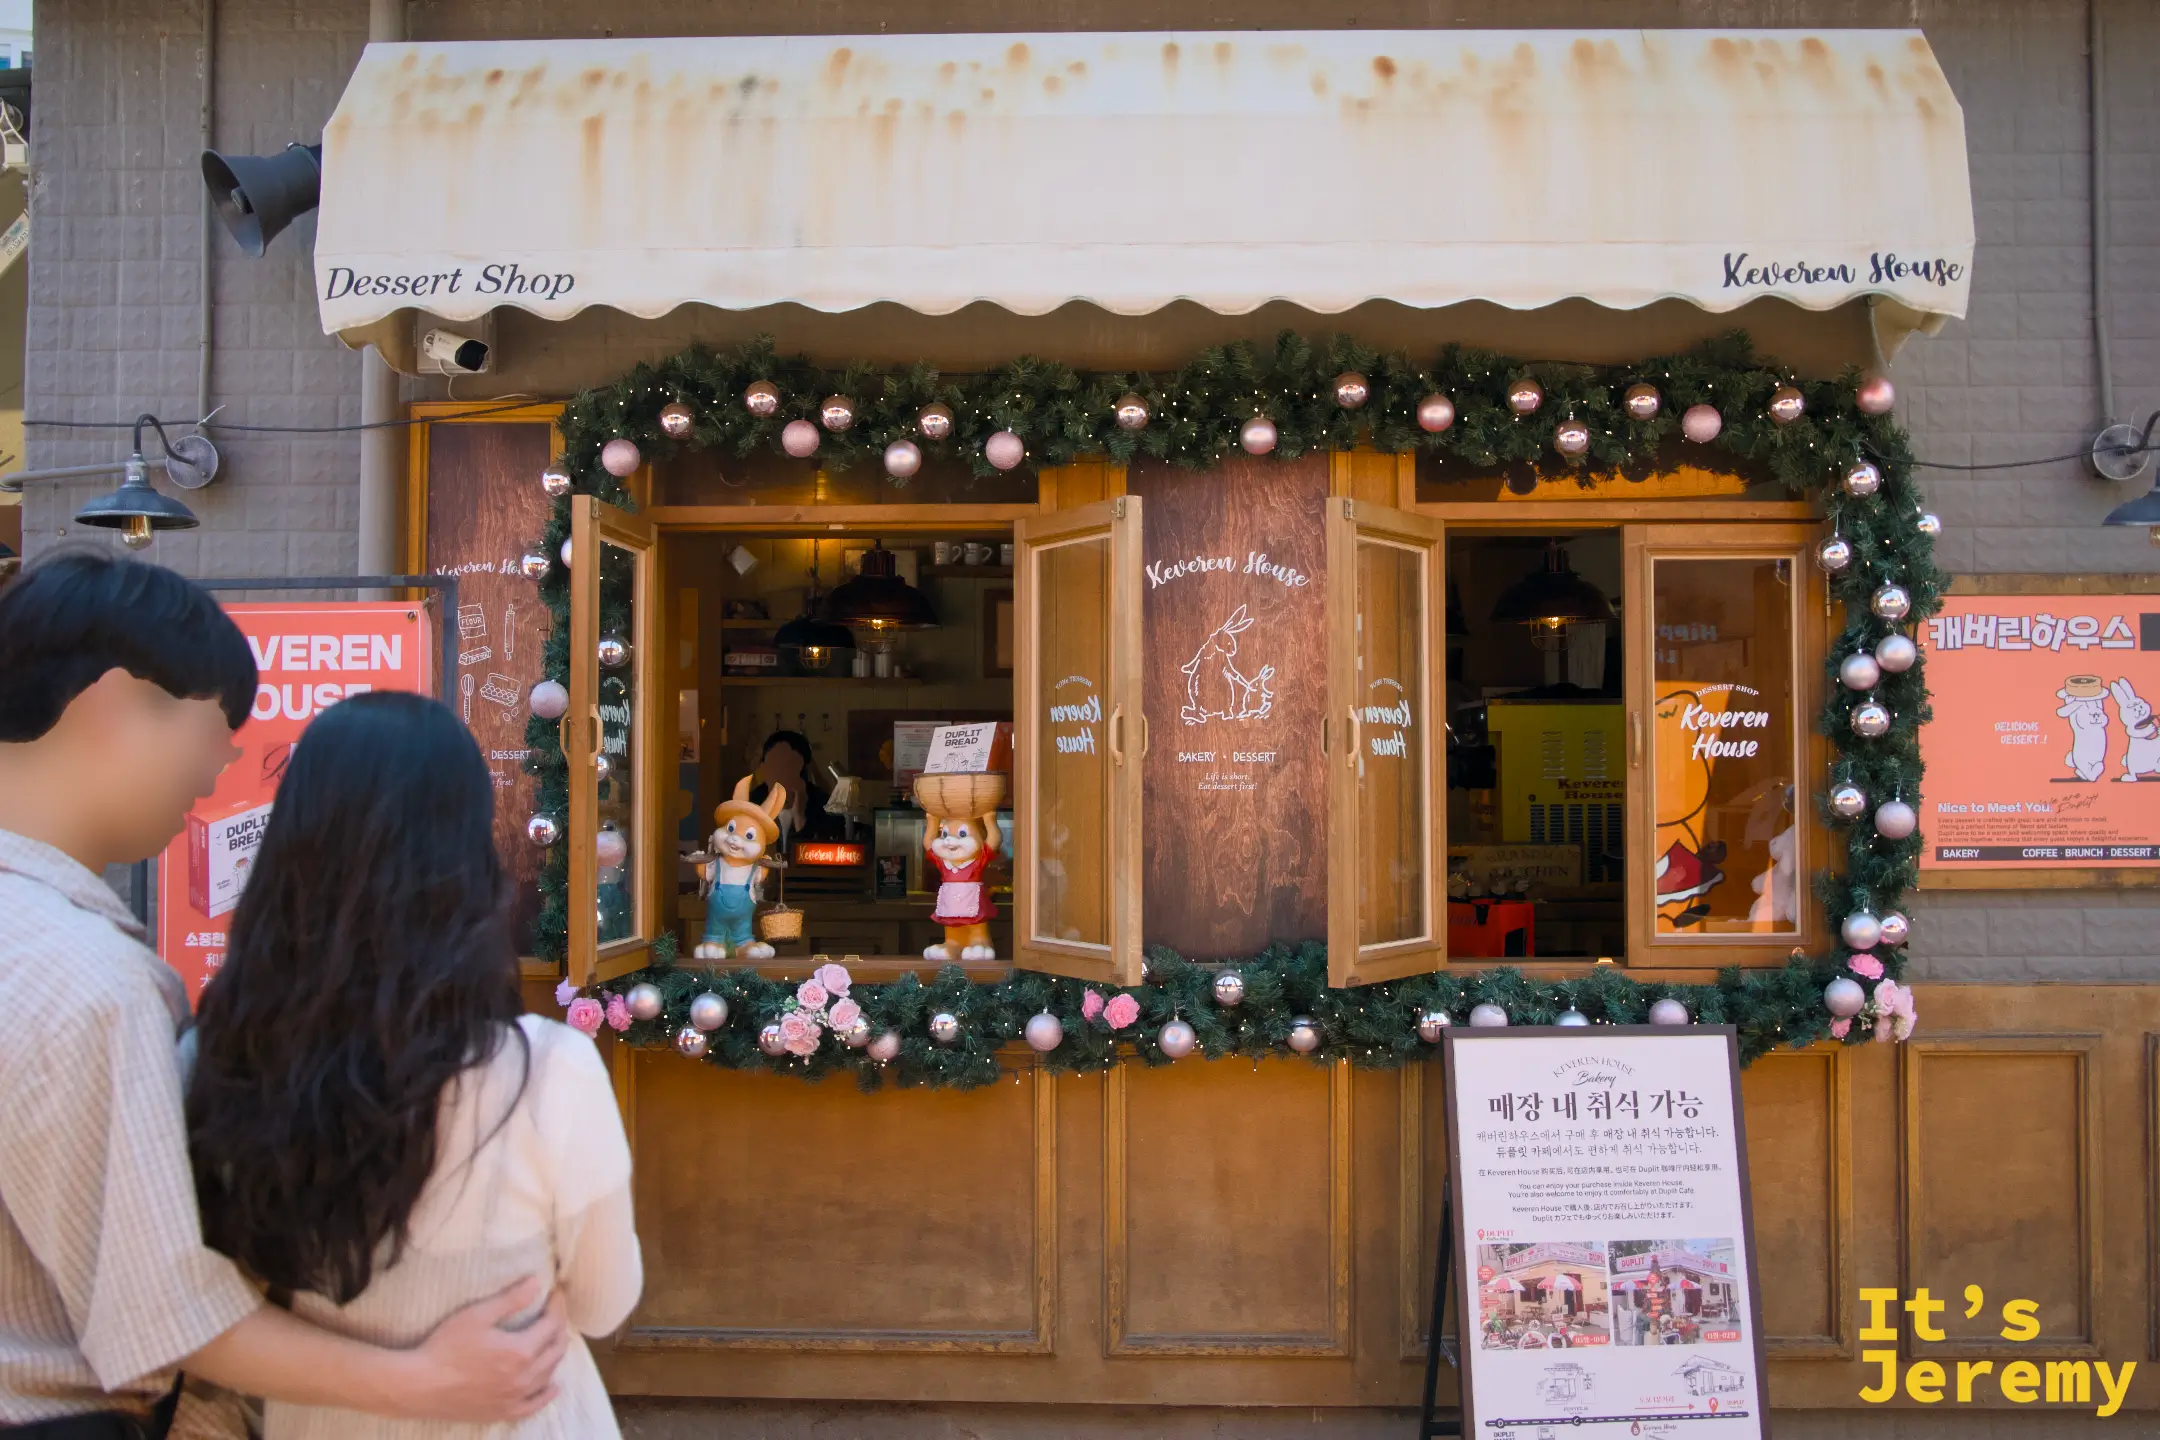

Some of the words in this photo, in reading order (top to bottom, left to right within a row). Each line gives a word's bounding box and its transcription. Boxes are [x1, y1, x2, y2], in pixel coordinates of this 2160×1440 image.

[1722, 252, 1856, 288] Keveren
[1868, 252, 1964, 287] House
[324, 267, 463, 300] Dessert
[475, 263, 575, 300] Shop
[1146, 556, 1236, 589] Keveren
[1243, 551, 1310, 587] House
[461, 617, 482, 626] FLOUR
[1928, 613, 2136, 652] 캐버린하우스
[247, 634, 402, 671] VEREN
[1695, 684, 1734, 697] DESSERT
[1735, 685, 1759, 697] SHOP
[251, 683, 372, 721] OUS
[1680, 704, 1769, 731] Keveren
[945, 728, 983, 739] DUPLIT
[945, 737, 978, 747] BREAD
[491, 750, 531, 760] DESSERT
[1691, 733, 1759, 761] House
[1178, 752, 1216, 762] BAKERY
[1233, 751, 1276, 762] DESSERT
[1205, 771, 1219, 781] Life
[1221, 772, 1228, 780] is
[1229, 771, 1250, 780] short.
[1198, 781, 1210, 790] Eat
[1212, 781, 1237, 790] dessert
[1238, 781, 1258, 791] first!
[1565, 791, 1623, 799] House
[1937, 802, 1968, 813] Nice
[1971, 802, 1984, 813] to
[1987, 802, 2022, 813] Meet
[2024, 802, 2053, 813] You.
[226, 813, 271, 839] DUPLI
[229, 830, 265, 851] BREA
[1942, 849, 1980, 858] BAKERY
[2022, 848, 2058, 858] COFFEE
[2065, 847, 2103, 857] BRUNCH
[2110, 846, 2152, 857] DESSERT
[1552, 1056, 1599, 1078] KEVEREN
[1602, 1056, 1636, 1077] HOUSE
[1572, 1070, 1616, 1088] Bakery
[1488, 1092, 1544, 1121] 매장
[1552, 1091, 1577, 1120] 내
[1586, 1090, 1640, 1120] 취식
[1650, 1089, 1704, 1119] 가능
[1476, 1130, 1560, 1143] 캐버린하우스에서
[1564, 1129, 1584, 1141] 구매
[1589, 1128, 1599, 1140] 후
[1603, 1128, 1624, 1140] 매장
[1627, 1127, 1637, 1139] 내
[1641, 1127, 1660, 1139] 취식
[1664, 1125, 1719, 1138] 가능합니다.
[1496, 1146, 1527, 1158] 듀플릿
[1531, 1145, 1584, 1157] 카페에서도
[1588, 1144, 1618, 1156] 편하게
[1622, 1143, 1642, 1155] 취식
[1647, 1142, 1702, 1155] 가능합니다.
[1487, 1168, 1516, 1176] Keveren
[1517, 1167, 1539, 1176] House
[1638, 1165, 1659, 1175] Duplit
[1540, 1204, 1562, 1212] House
